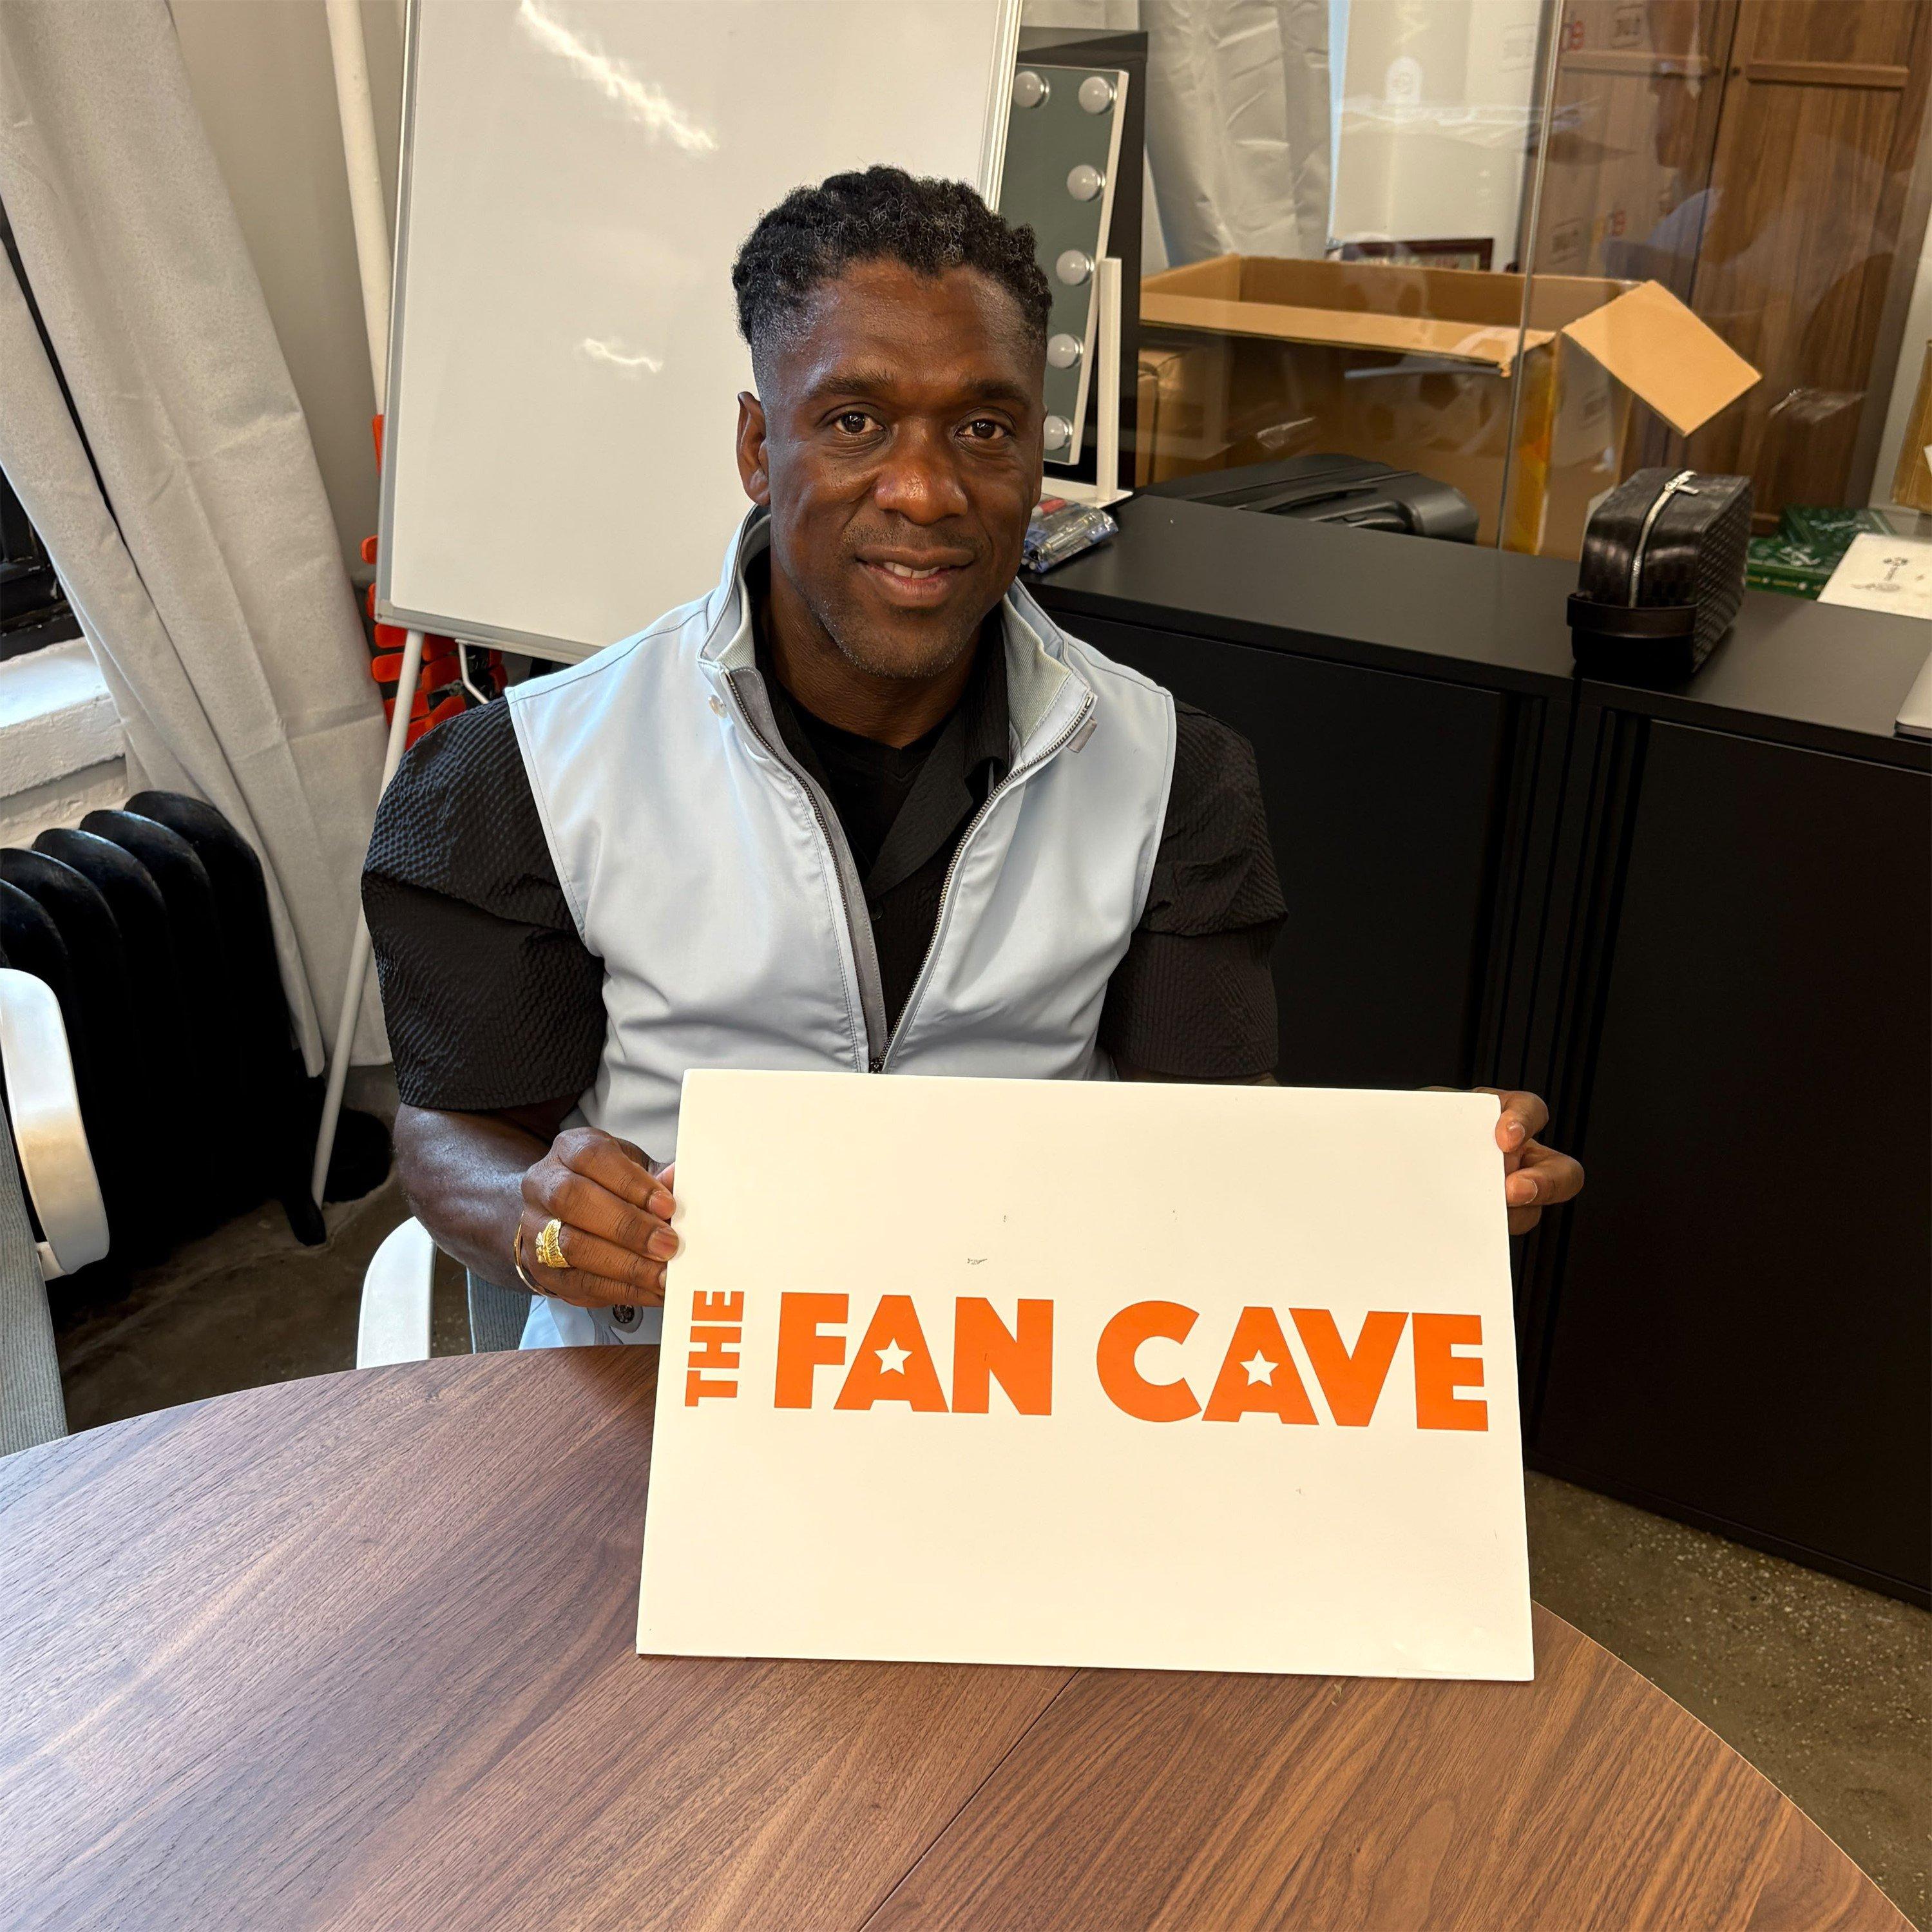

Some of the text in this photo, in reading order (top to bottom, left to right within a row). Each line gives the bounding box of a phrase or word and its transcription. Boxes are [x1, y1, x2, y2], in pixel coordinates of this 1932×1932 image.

[685, 1290, 1489, 1432] THE FAN CAVE
